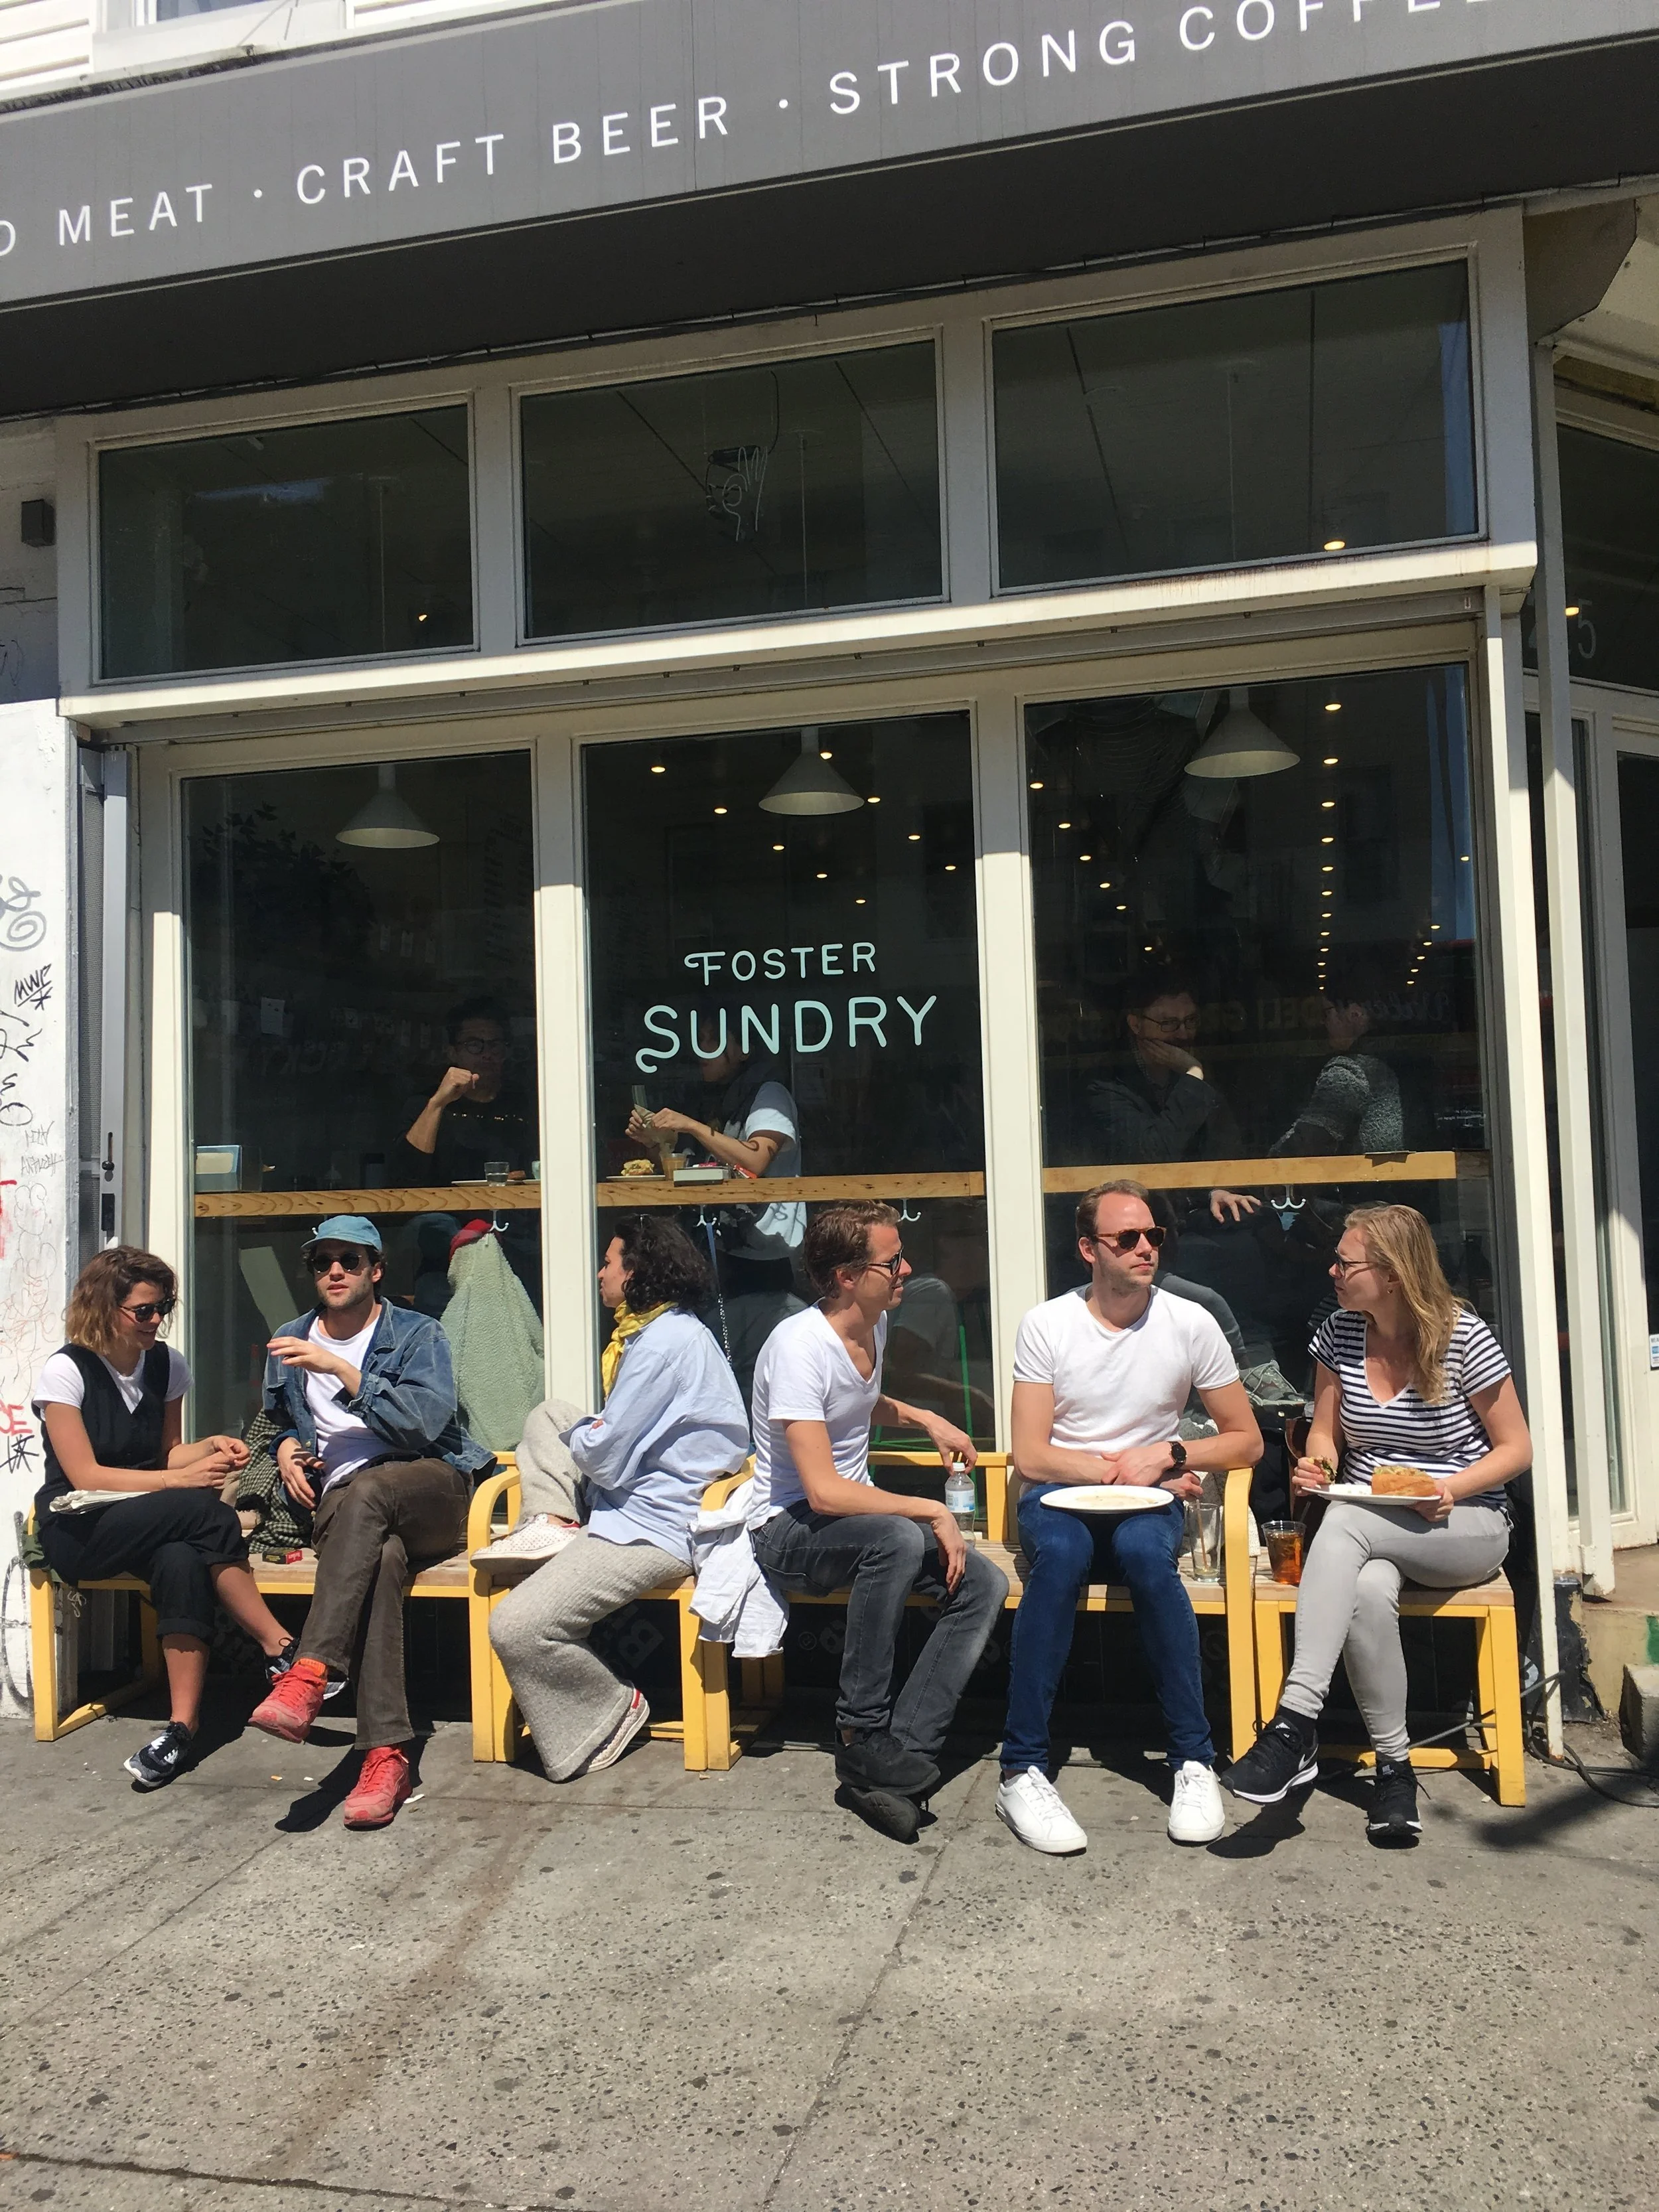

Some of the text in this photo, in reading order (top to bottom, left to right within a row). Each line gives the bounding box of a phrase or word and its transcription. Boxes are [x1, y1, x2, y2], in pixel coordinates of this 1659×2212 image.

[59, 184, 212, 246] MEAT
[297, 133, 504, 204] CRAFT
[553, 96, 728, 164] BEER
[830, 21, 1135, 115] STRONG
[684, 942, 875, 986] FOSTER
[635, 995, 937, 1073] SUNDRY
